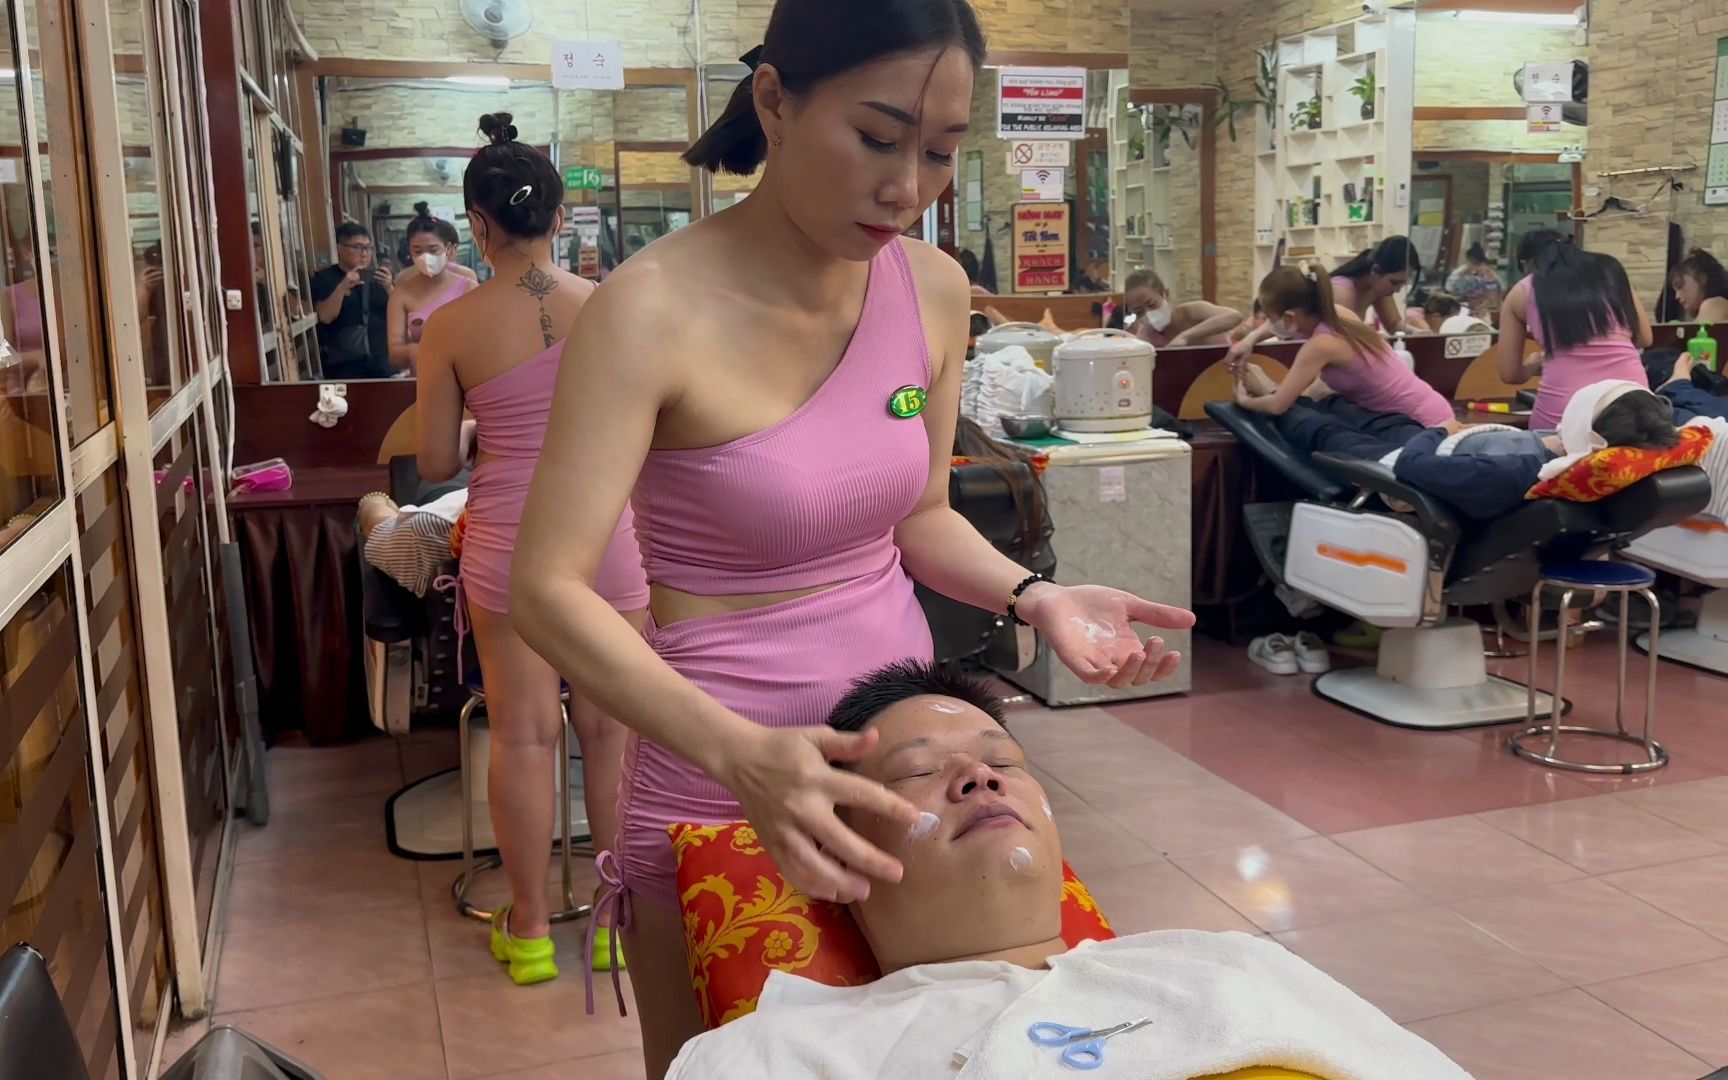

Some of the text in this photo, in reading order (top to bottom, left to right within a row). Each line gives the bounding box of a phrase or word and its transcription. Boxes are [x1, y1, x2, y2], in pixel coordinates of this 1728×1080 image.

[563, 52, 605, 69] 정 숙
[898, 390, 920, 413] 15
